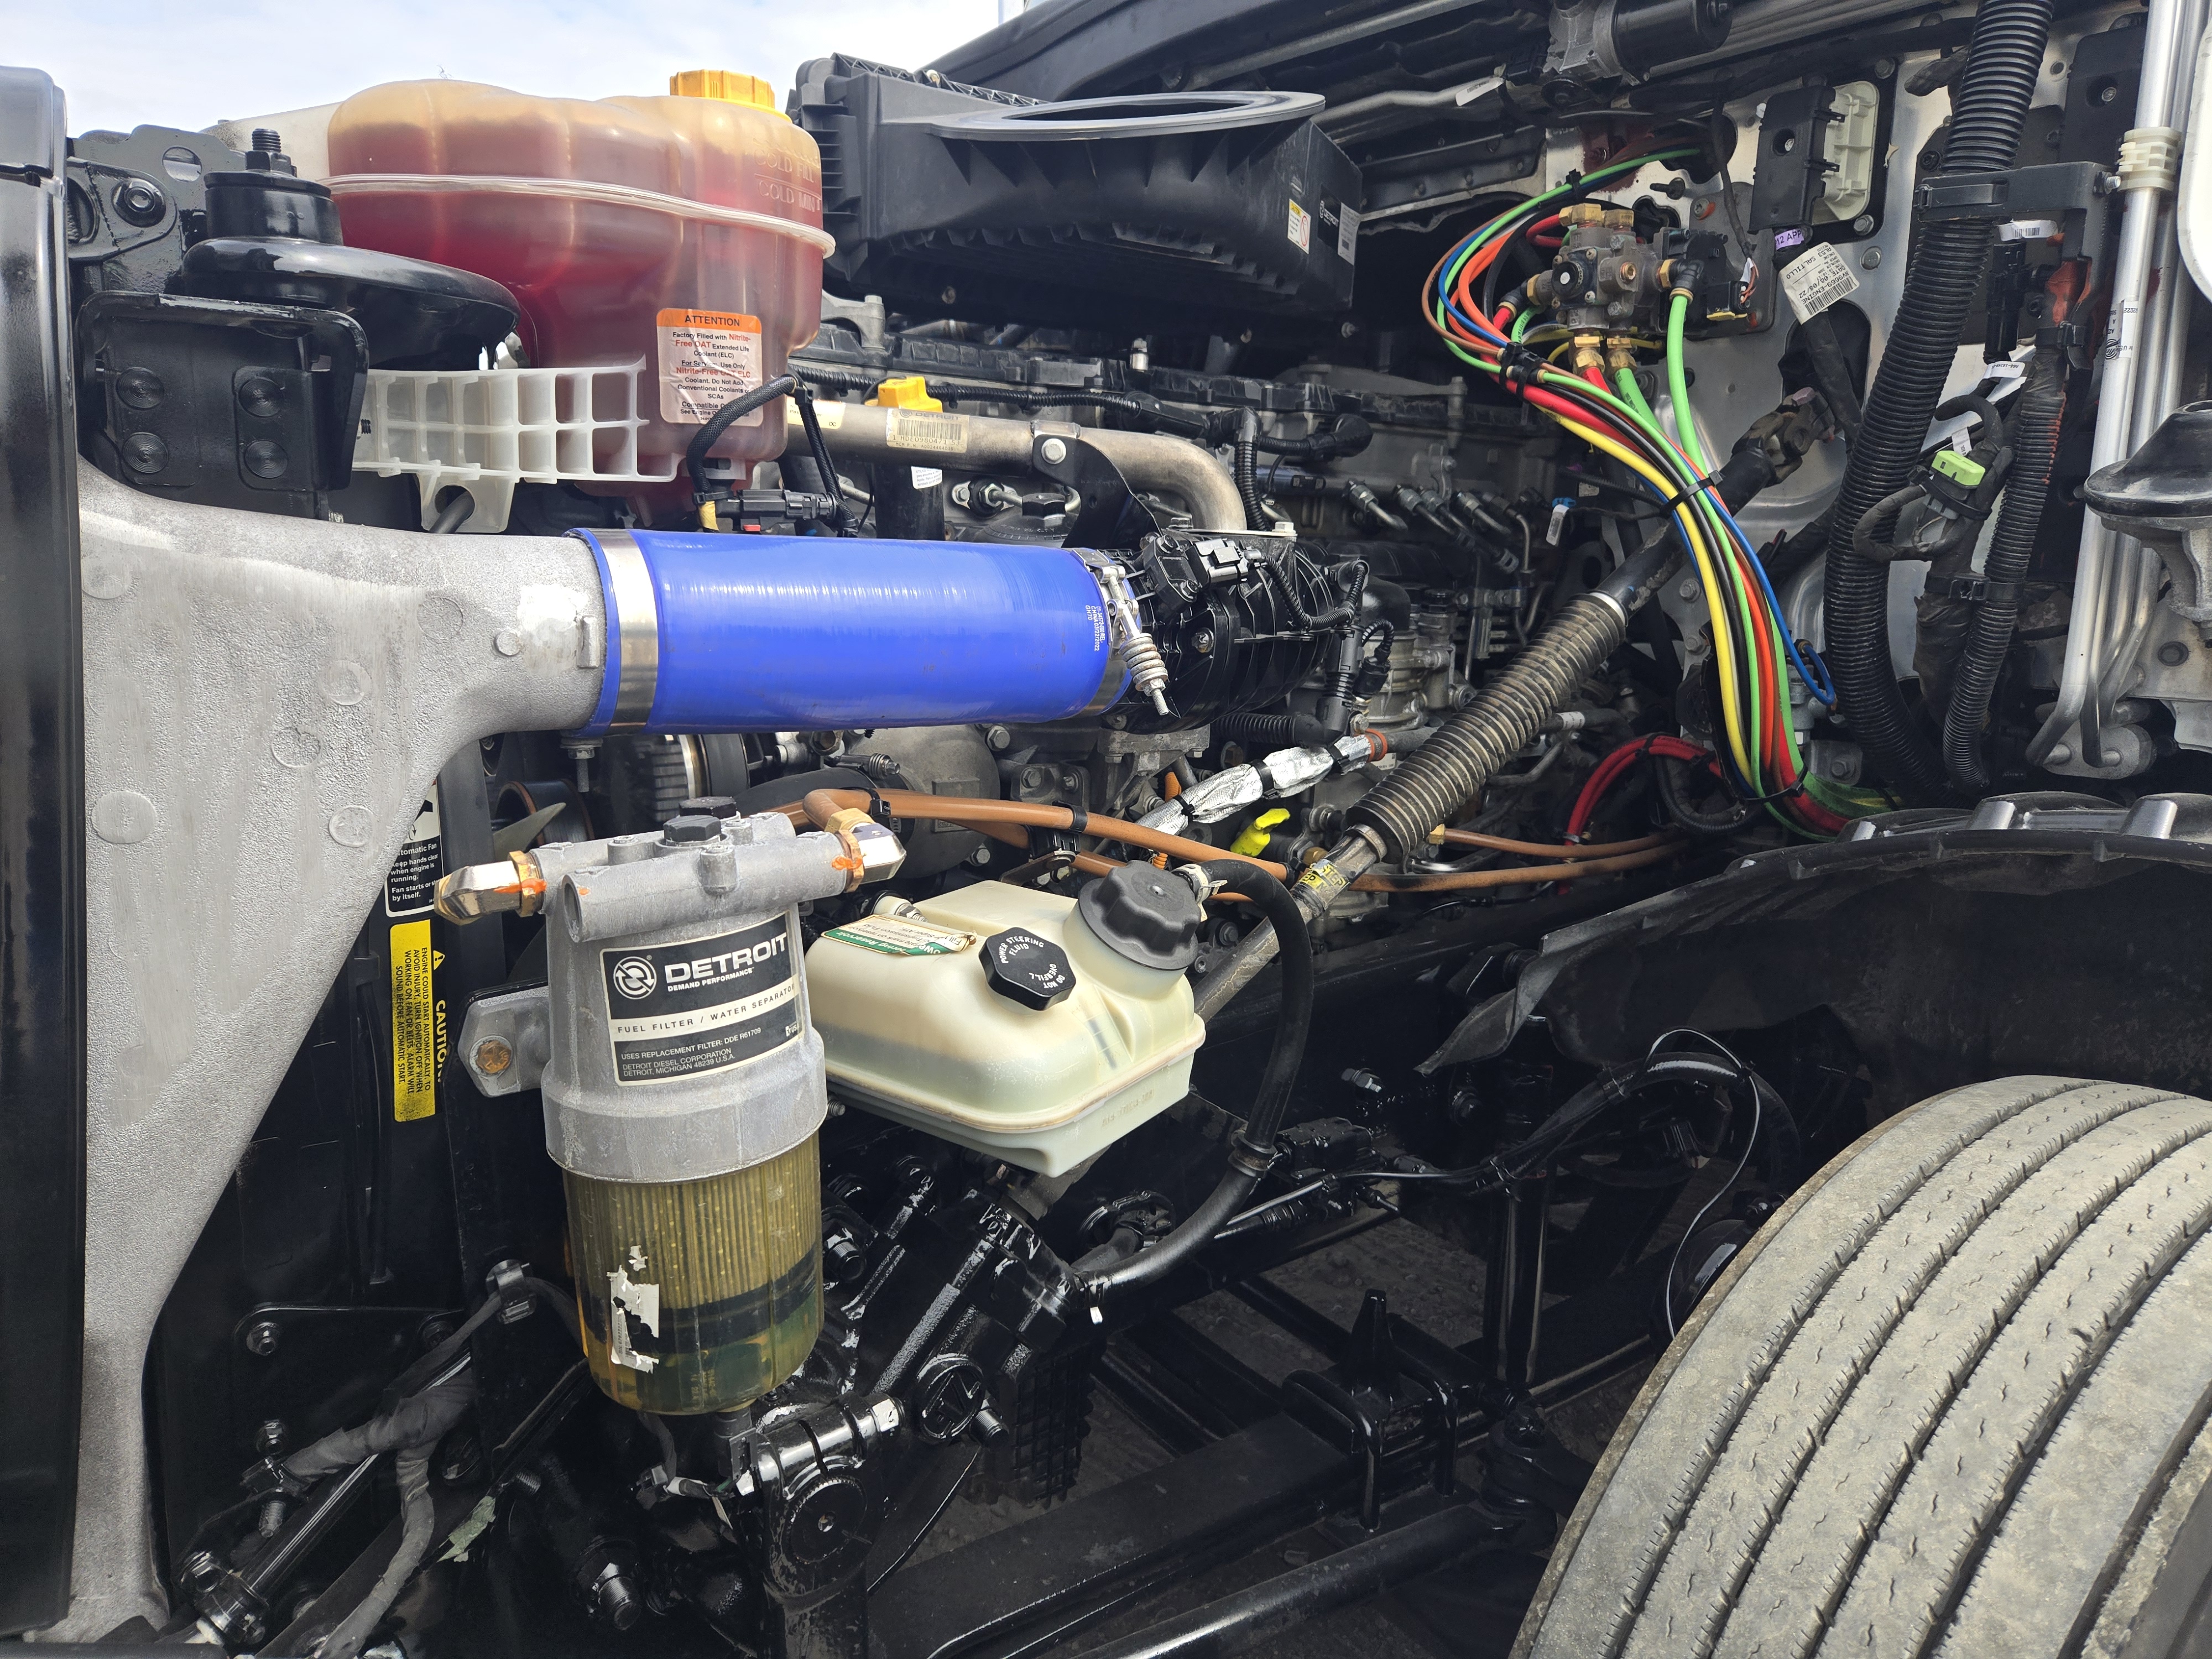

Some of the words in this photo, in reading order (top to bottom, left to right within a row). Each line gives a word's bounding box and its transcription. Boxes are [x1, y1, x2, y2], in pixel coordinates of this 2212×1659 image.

[758, 180, 795, 204] COLD
[1787, 229, 1802, 241] APP
[1786, 256, 1816, 279] SALTILLO
[1801, 270, 1849, 305] NV9669-ENGINE
[685, 315, 740, 327] ATTENTION
[729, 333, 751, 342] Nitrite-
[676, 367, 718, 376] Nitrite-Free
[677, 384, 718, 392] Conventional
[915, 412, 961, 420] DETROIT
[428, 842, 437, 851] Fan
[409, 857, 427, 865] hands
[390, 867, 409, 875] when
[410, 864, 429, 873] engine
[391, 874, 419, 883] running.
[406, 883, 424, 892] starts
[402, 891, 421, 900] itself.
[836, 932, 879, 945] Reservoir
[881, 928, 923, 942] Transmission
[948, 936, 962, 946] Fill
[999, 943, 1009, 963] POWER
[1006, 936, 1044, 948] STEERING
[1009, 943, 1029, 956] FLUID
[664, 932, 787, 984] DETROIT
[1029, 963, 1057, 981] OVERFILL
[667, 980, 700, 992] DEMAND
[702, 968, 753, 986] PERFORMANCE
[1056, 974, 1066, 984] DO
[405, 988, 413, 1000] ON
[406, 1018, 413, 1028] OR
[618, 1025, 646, 1034] FUEL
[652, 1019, 693, 1031] FILTER
[710, 1005, 747, 1020] WATER
[621, 1052, 640, 1060] USES
[641, 1045, 696, 1058] REPLACEMENT
[697, 1040, 723, 1051] FILTER:
[724, 1035, 739, 1044] DDE
[739, 1027, 761, 1040] R61709
[623, 1062, 652, 1071] DETROIT
[654, 1059, 679, 1068] DIESEL
[680, 1047, 732, 1064] CORPORATION
[656, 1064, 692, 1074] MICHIGAN
[693, 1057, 714, 1068] 48239
[716, 1053, 735, 1063] U.S.A.
[424, 1080, 431, 1091] TO
